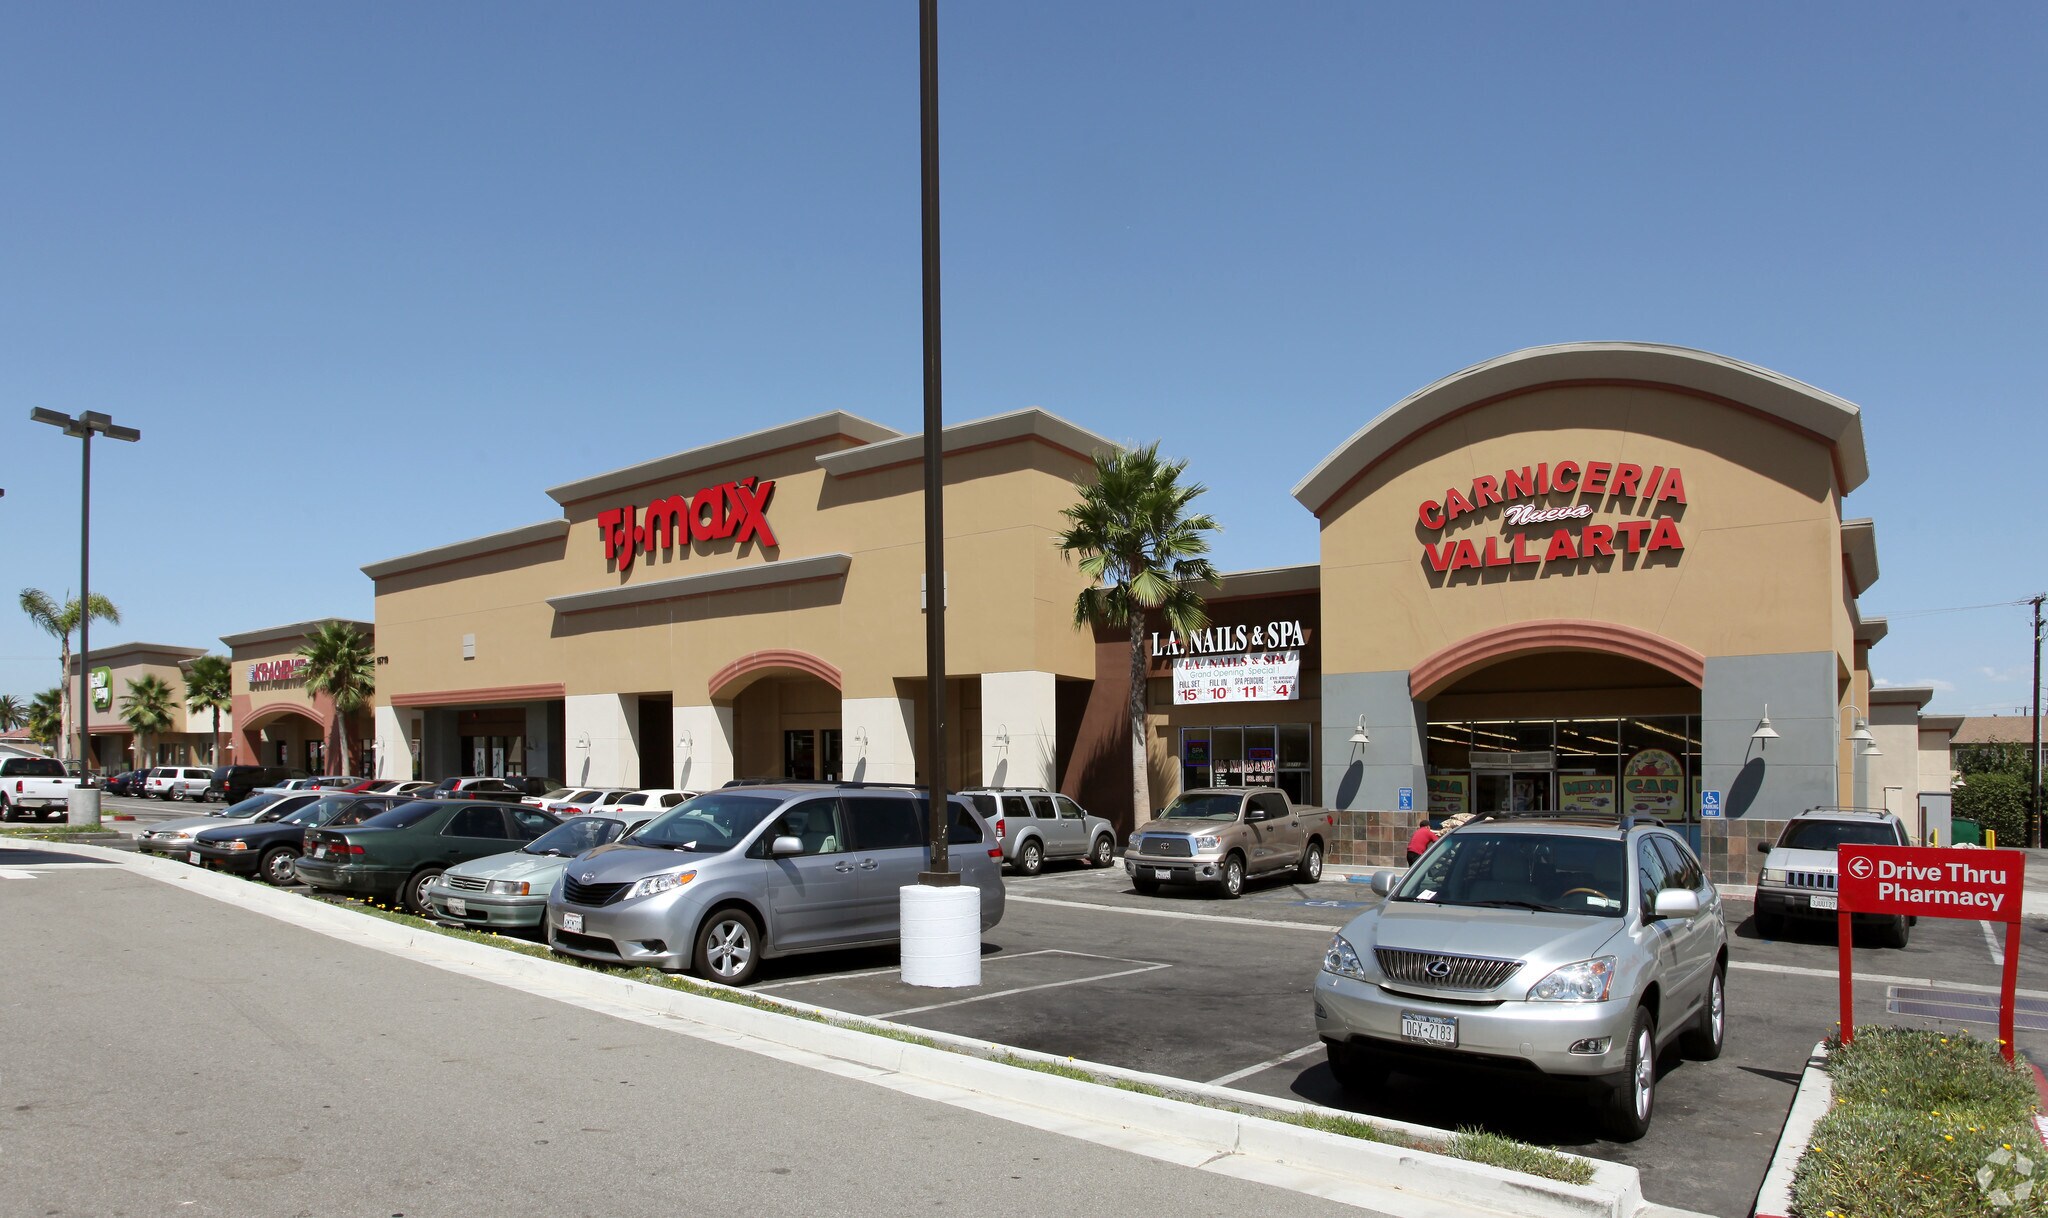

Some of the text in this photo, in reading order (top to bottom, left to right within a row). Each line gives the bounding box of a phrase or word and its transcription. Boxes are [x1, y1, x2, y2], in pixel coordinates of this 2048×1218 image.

[1418, 460, 1688, 530] CARNICERIA
[1504, 504, 1593, 525] Nueva
[1425, 517, 1685, 571] VALLARTA
[1189, 624, 1247, 654] NAILS
[1251, 625, 1263, 646] &
[1267, 620, 1305, 649] SPA
[254, 659, 295, 682] KRAGEN
[1208, 656, 1248, 669] NAILS
[1263, 654, 1287, 666] SPA
[1189, 670, 1212, 679] Grand
[1213, 668, 1245, 678] Opening
[1248, 666, 1276, 676] Special
[1209, 678, 1220, 687] FILL
[1234, 676, 1265, 685] SPA PEDICURE
[1179, 679, 1201, 689] FULL SET
[1563, 780, 1613, 796] MEXI
[1626, 779, 1679, 794] CAN
[1878, 860, 2007, 885] Drive Thru
[1878, 882, 2005, 912] Pharmacy
